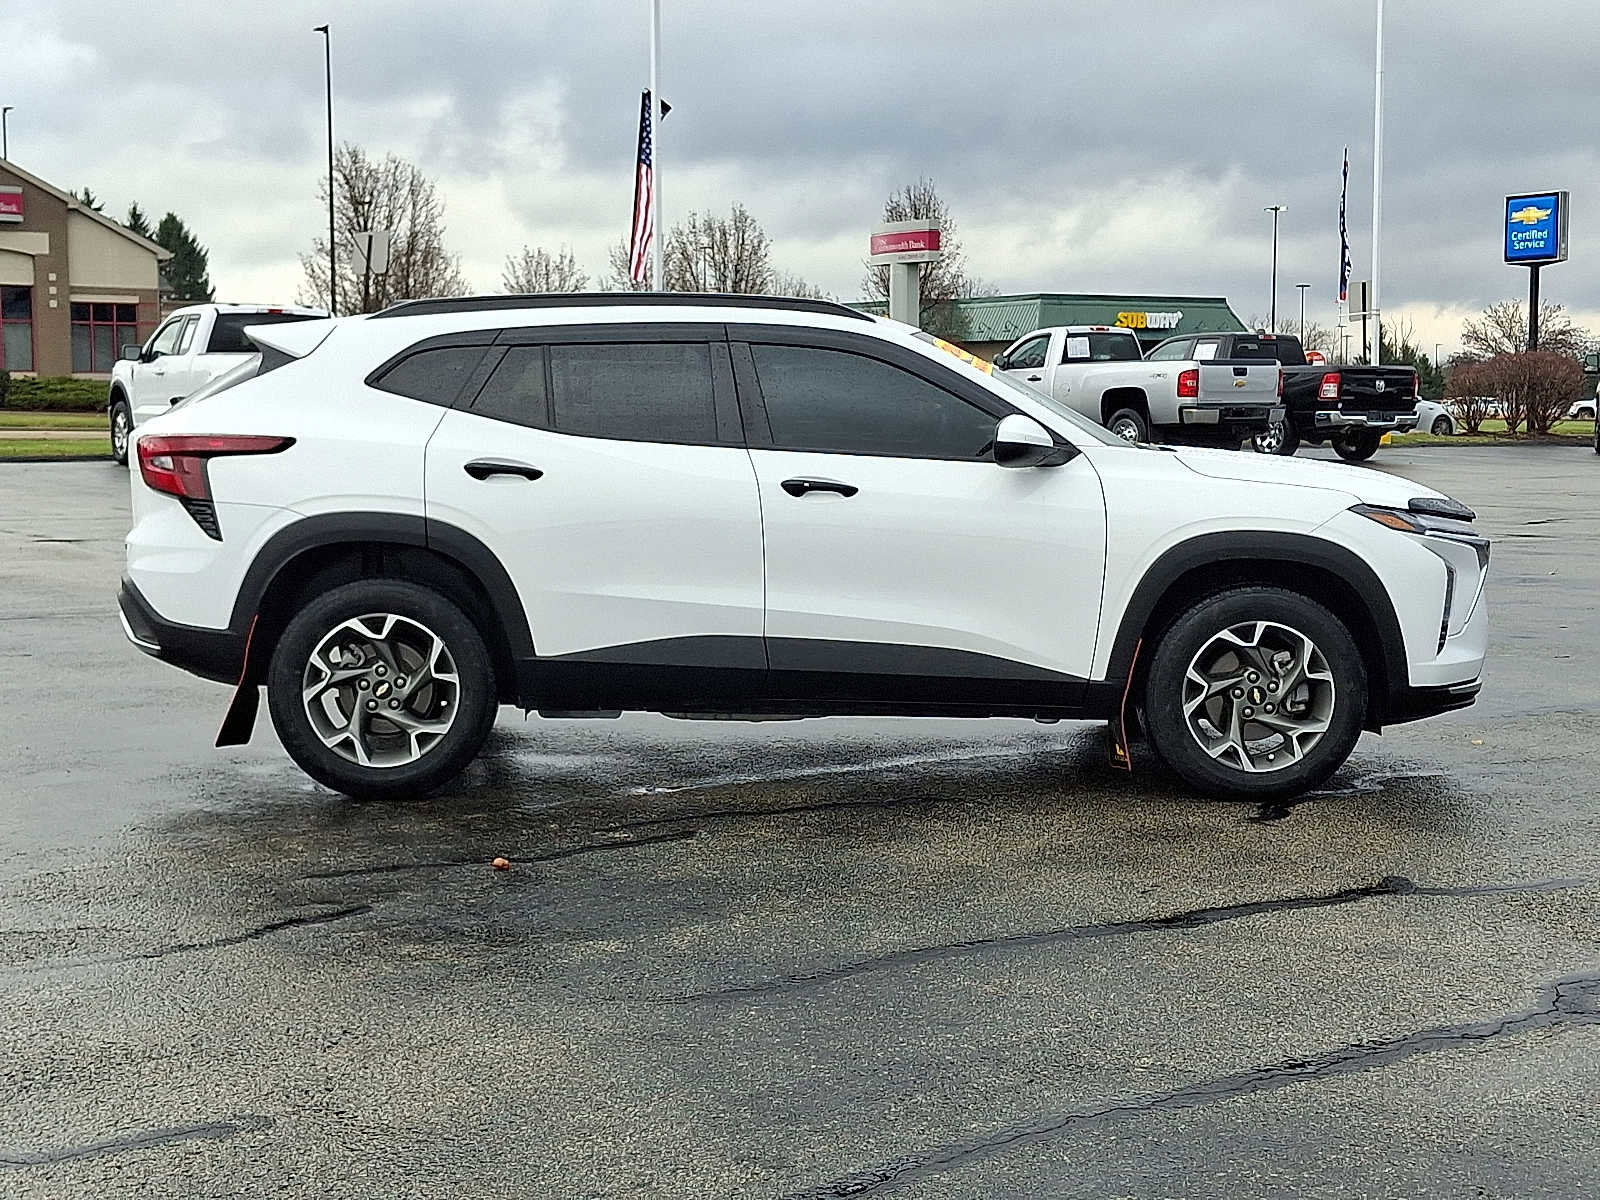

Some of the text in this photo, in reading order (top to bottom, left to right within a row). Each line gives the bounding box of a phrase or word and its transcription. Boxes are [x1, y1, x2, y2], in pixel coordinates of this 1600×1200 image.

[1511, 229, 1548, 241] Certified
[908, 240, 925, 249] Bank
[1513, 240, 1545, 250] Service
[1114, 310, 1183, 329] SUBWAY
